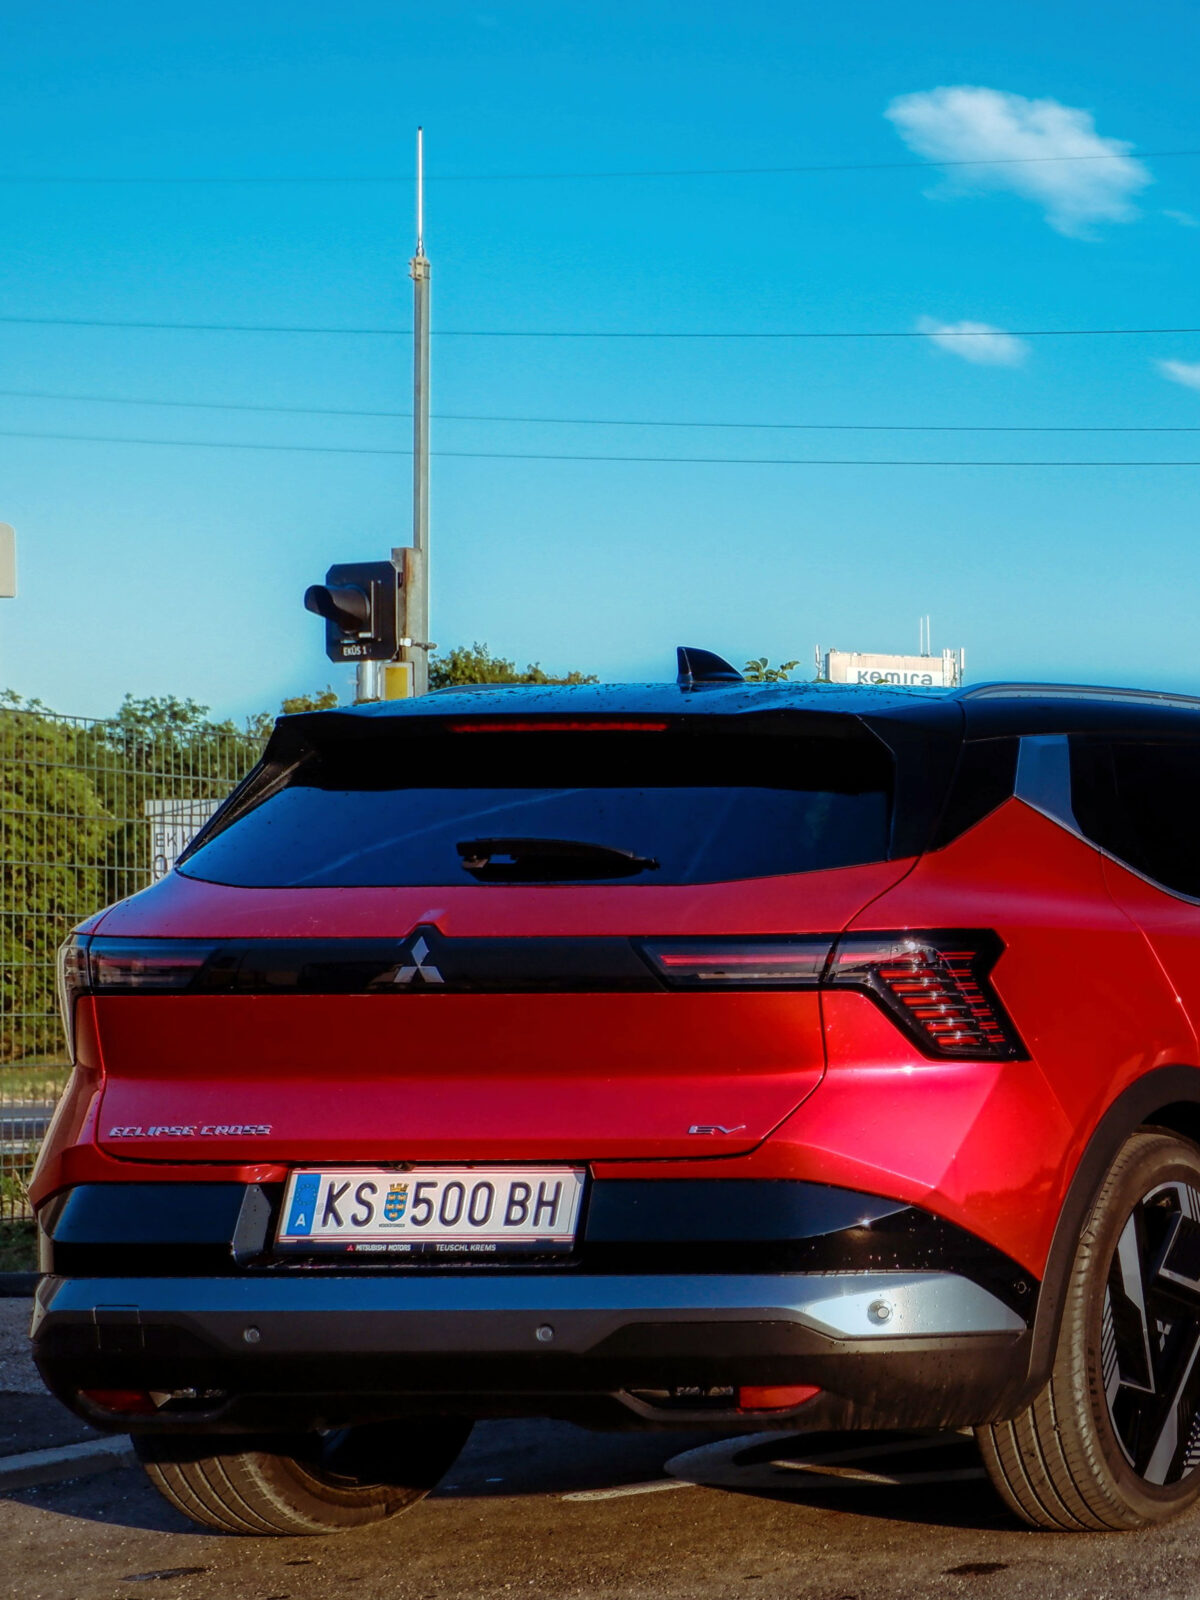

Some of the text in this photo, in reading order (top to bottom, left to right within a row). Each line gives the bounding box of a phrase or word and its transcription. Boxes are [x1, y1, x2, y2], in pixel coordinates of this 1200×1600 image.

[109, 1124, 273, 1137] ECLIPSE CROSS
[688, 1124, 747, 1134] EV
[321, 1180, 562, 1227] KS 500 BH
[295, 1214, 306, 1227] A
[436, 1243, 468, 1251] TEUSCHL
[470, 1243, 496, 1251] KREMS
